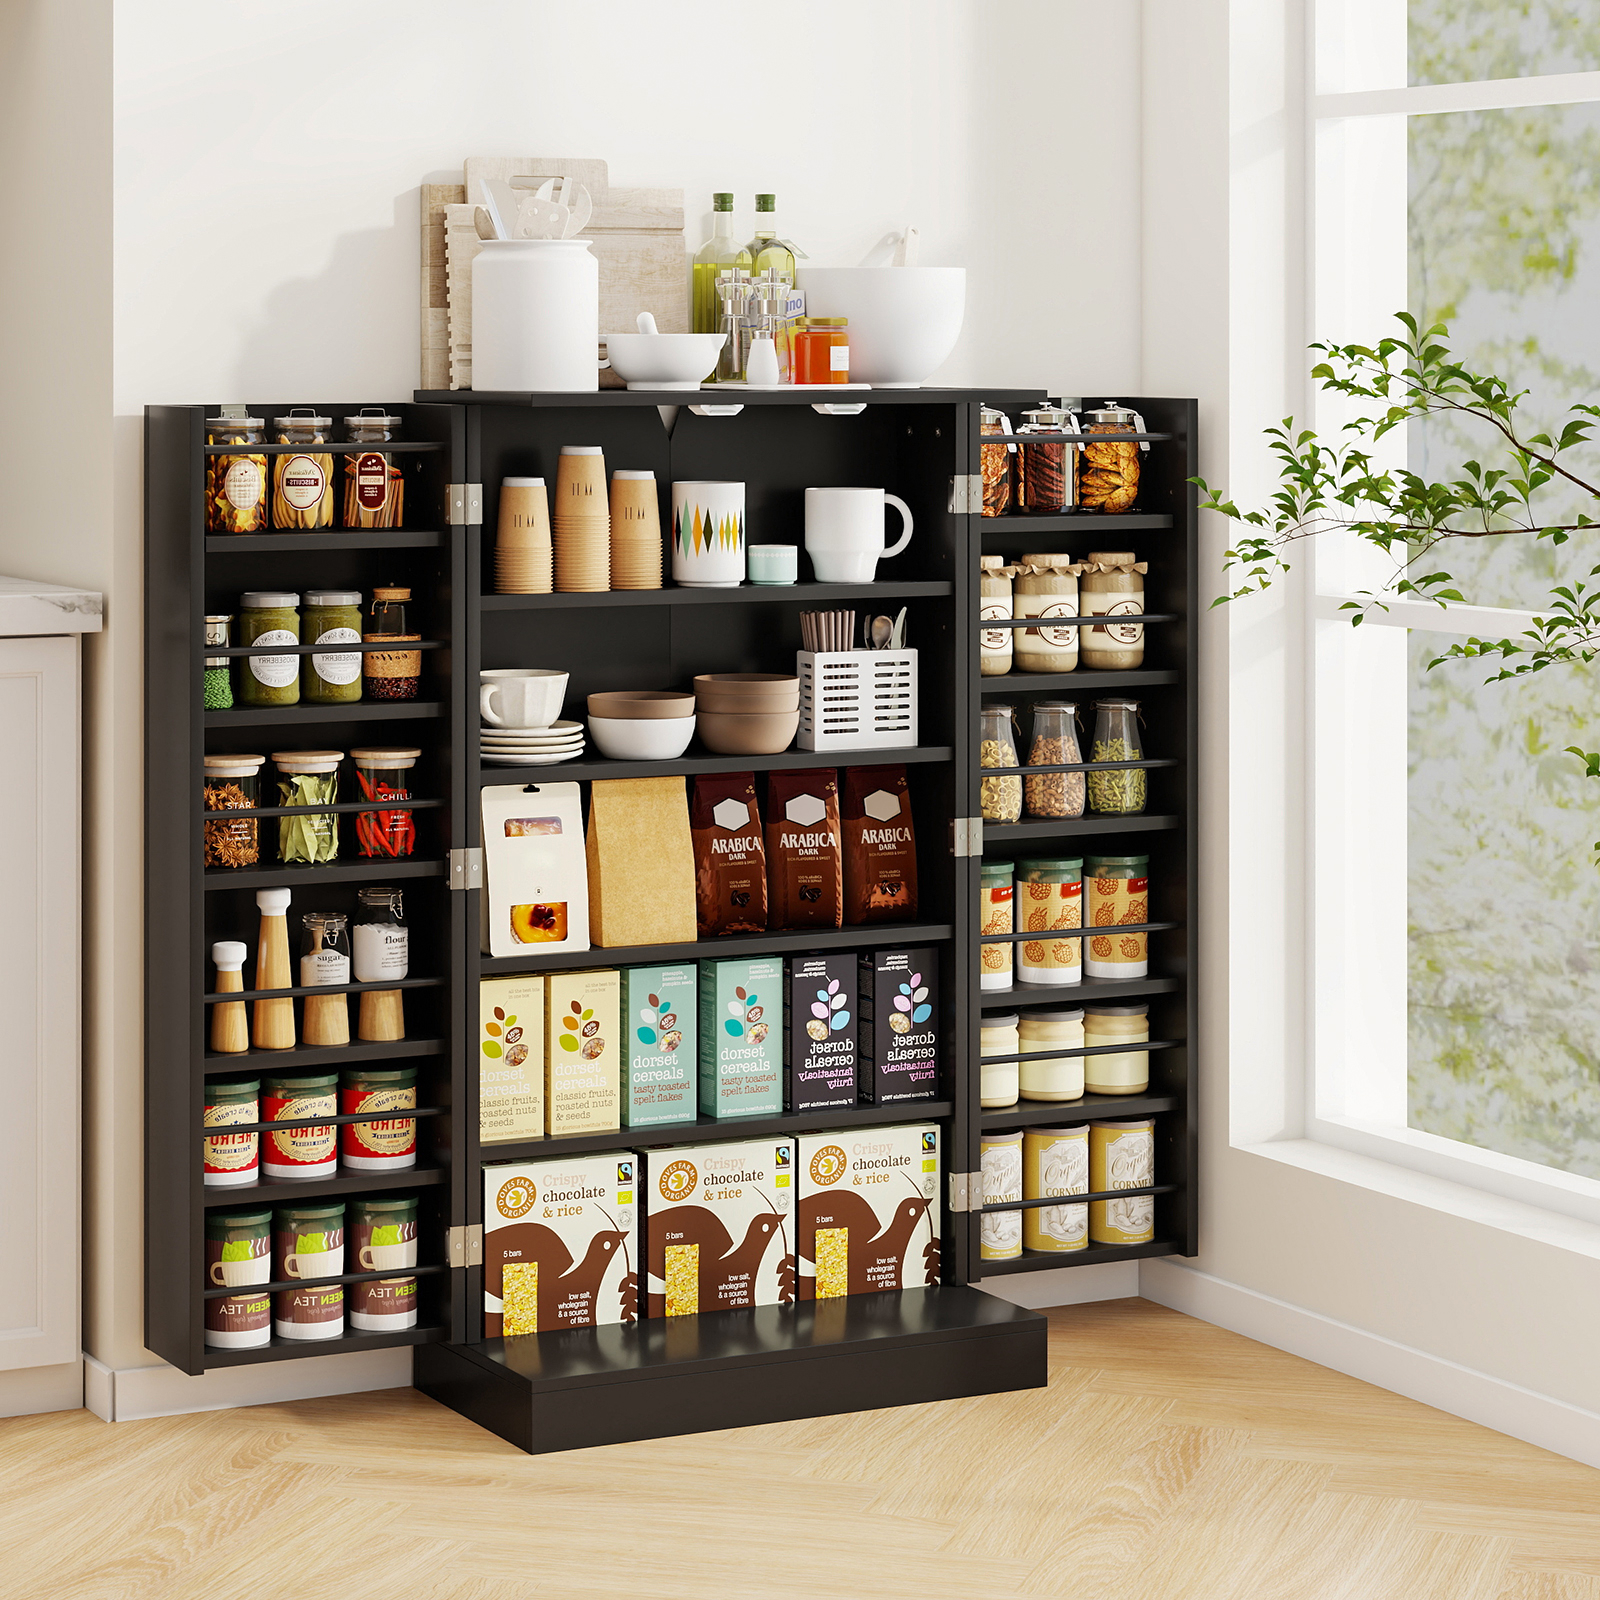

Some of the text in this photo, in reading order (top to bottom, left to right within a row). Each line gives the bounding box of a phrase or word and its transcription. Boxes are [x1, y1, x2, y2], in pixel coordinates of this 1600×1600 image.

[227, 801, 251, 810] STAR
[779, 833, 836, 848] ARABICA
[861, 827, 911, 844] ARABICA
[711, 836, 761, 854] ARABICA
[878, 843, 897, 851] DARK
[728, 853, 746, 861] DARK
[385, 936, 405, 944] flour
[317, 955, 341, 963] sugar
[721, 1045, 765, 1061] dorset
[633, 1053, 678, 1069] dorset
[721, 1059, 770, 1075] cereals
[555, 1061, 601, 1076] dorset
[633, 1067, 684, 1083] cereals
[555, 1075, 606, 1091] cereals
[721, 1073, 777, 1086] tasty toasted
[634, 1081, 690, 1094] tasty toasted
[721, 1084, 769, 1097] spelt flakes
[512, 1096, 540, 1105] fruits,
[556, 1089, 616, 1101] classic fruits,
[634, 1092, 683, 1105] spelt flakes
[516, 1106, 536, 1115] nuts
[556, 1099, 613, 1111] roasted nuts
[489, 1118, 514, 1127] seeds
[556, 1111, 590, 1121] & seeds
[853, 1142, 894, 1155] Crispy
[703, 1157, 747, 1171] Crispy
[811, 1148, 845, 1173] DOVES FARM
[852, 1154, 911, 1171] chocolate
[543, 1173, 587, 1188] Crispy
[661, 1162, 695, 1189] DOVES FARM
[703, 1169, 764, 1186] chocolate
[815, 1164, 844, 1184] ORGANIC
[852, 1172, 890, 1185] & rice
[498, 1179, 535, 1206] DOVES FARM
[542, 1187, 606, 1203] chocolate
[665, 1180, 695, 1199] ORGANIC
[703, 1187, 742, 1201] & rice
[502, 1197, 534, 1217] ORGANIC
[543, 1204, 583, 1218] & rice
[821, 1215, 833, 1223] bars
[671, 1231, 684, 1239] bars
[509, 1249, 522, 1257] bars
[866, 1265, 895, 1273] wholegrain
[718, 1281, 747, 1290] wholegrain
[878, 1280, 884, 1288] of
[558, 1300, 588, 1309] wholegrain
